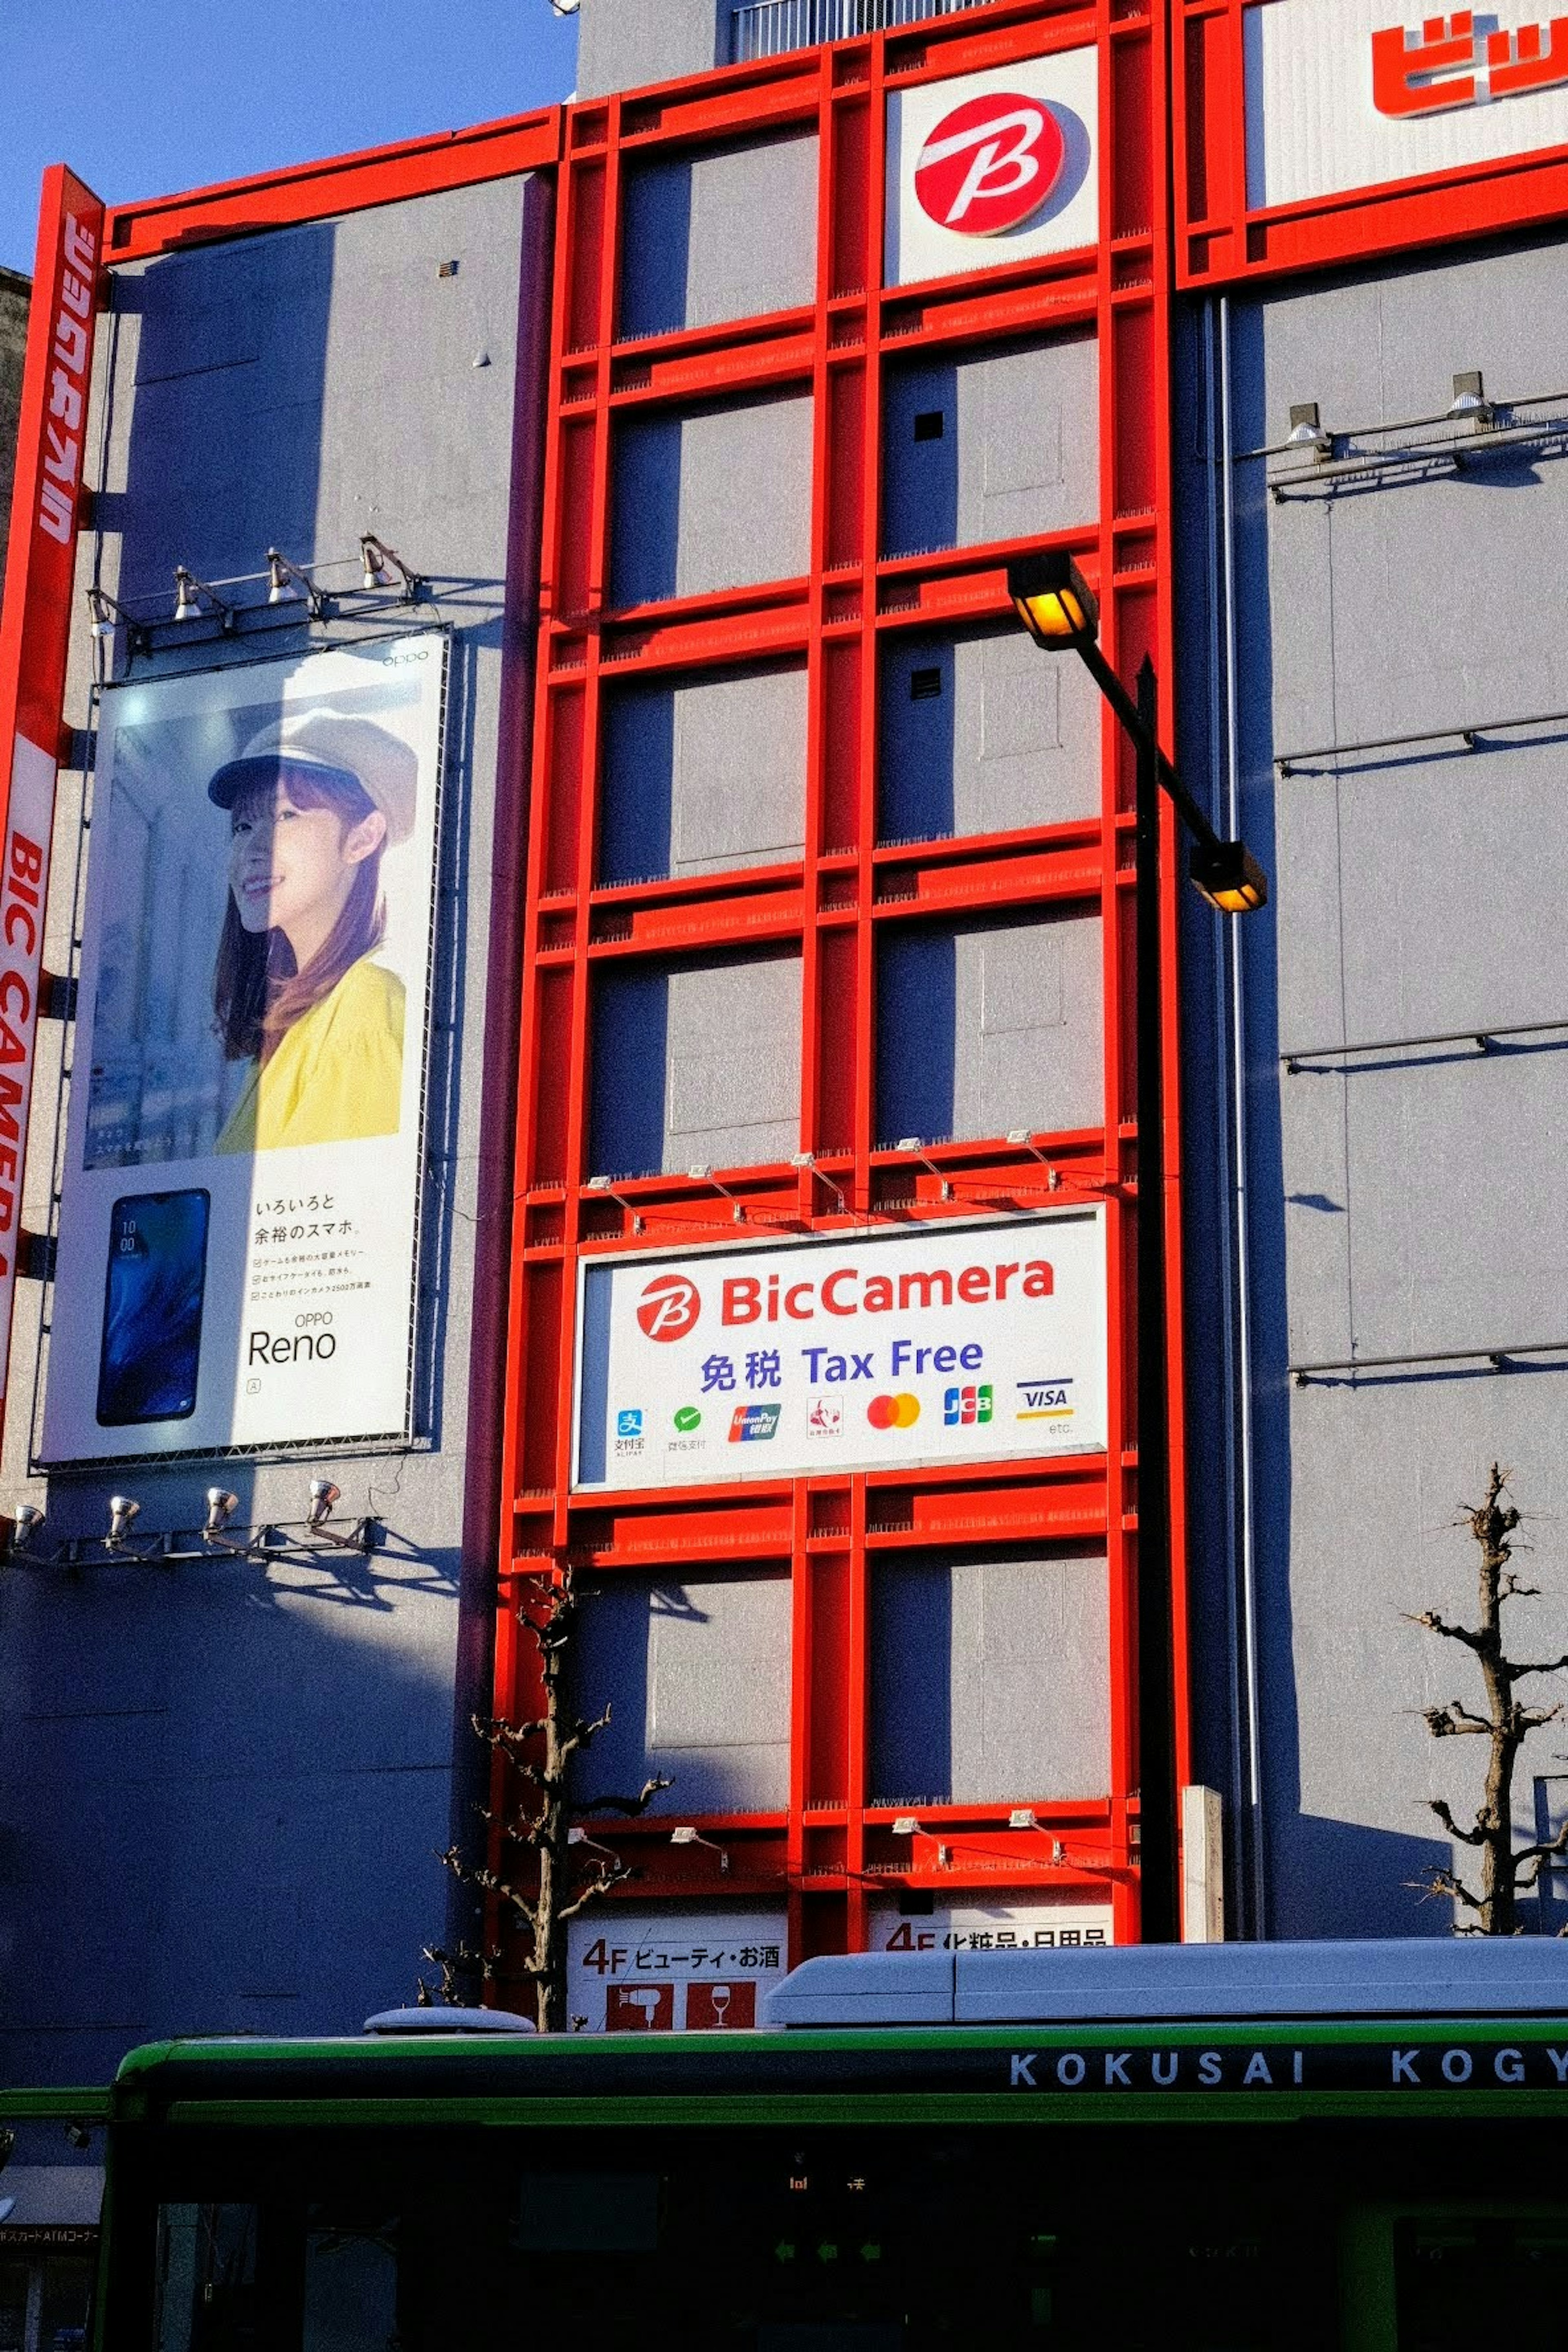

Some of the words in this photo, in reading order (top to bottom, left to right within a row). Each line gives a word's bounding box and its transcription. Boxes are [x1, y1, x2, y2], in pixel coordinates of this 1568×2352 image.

[38, 212, 95, 545] ビックカメラ
[4, 830, 42, 956] BIC
[256, 1194, 334, 1216] いろいろと
[255, 1219, 359, 1245] 余裕のスマホ。
[722, 1260, 1054, 1326] BicCamera
[295, 1311, 333, 1327] OPPO
[249, 1331, 336, 1366] Reno
[701, 1349, 782, 1393] 免税
[801, 1347, 875, 1383] Tax
[891, 1339, 984, 1376] Free
[1024, 1390, 1067, 1407] VISA
[733, 1412, 778, 1425] UnionPay
[1049, 1423, 1073, 1434] etc.
[583, 1939, 628, 1975] 4F
[636, 1946, 780, 1970] ビューティ・お酒
[1009, 2051, 1303, 2085] KOKUSAI
[1392, 2047, 1568, 2083] KOGY
